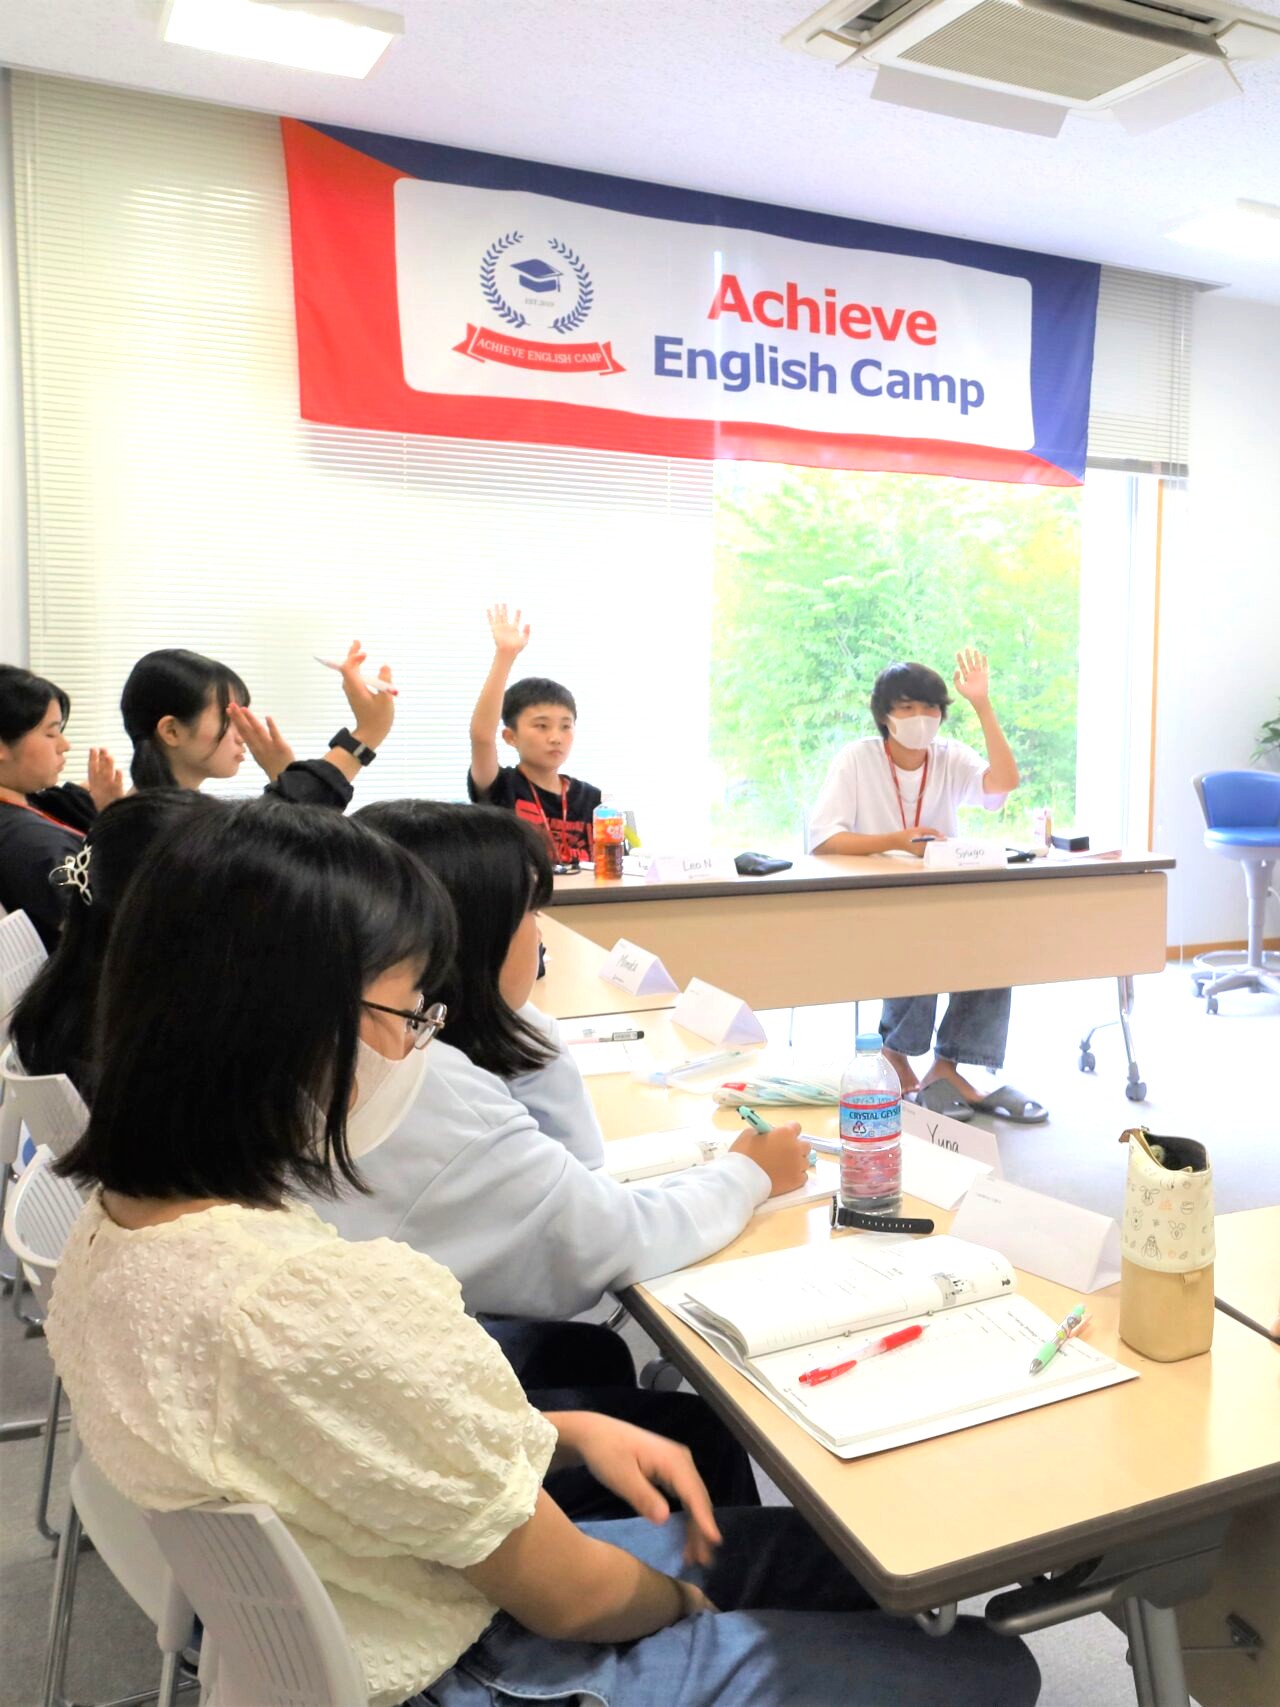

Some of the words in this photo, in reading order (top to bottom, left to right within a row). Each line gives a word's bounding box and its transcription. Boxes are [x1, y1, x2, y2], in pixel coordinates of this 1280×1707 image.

[707, 273, 939, 346] Achieve
[477, 338, 526, 359] ACHIEVE
[527, 349, 572, 364] ENGLISH
[574, 352, 602, 364] CAMP
[653, 334, 838, 393] English
[850, 358, 986, 416] Camp
[849, 1111, 880, 1121] CRYSTAL
